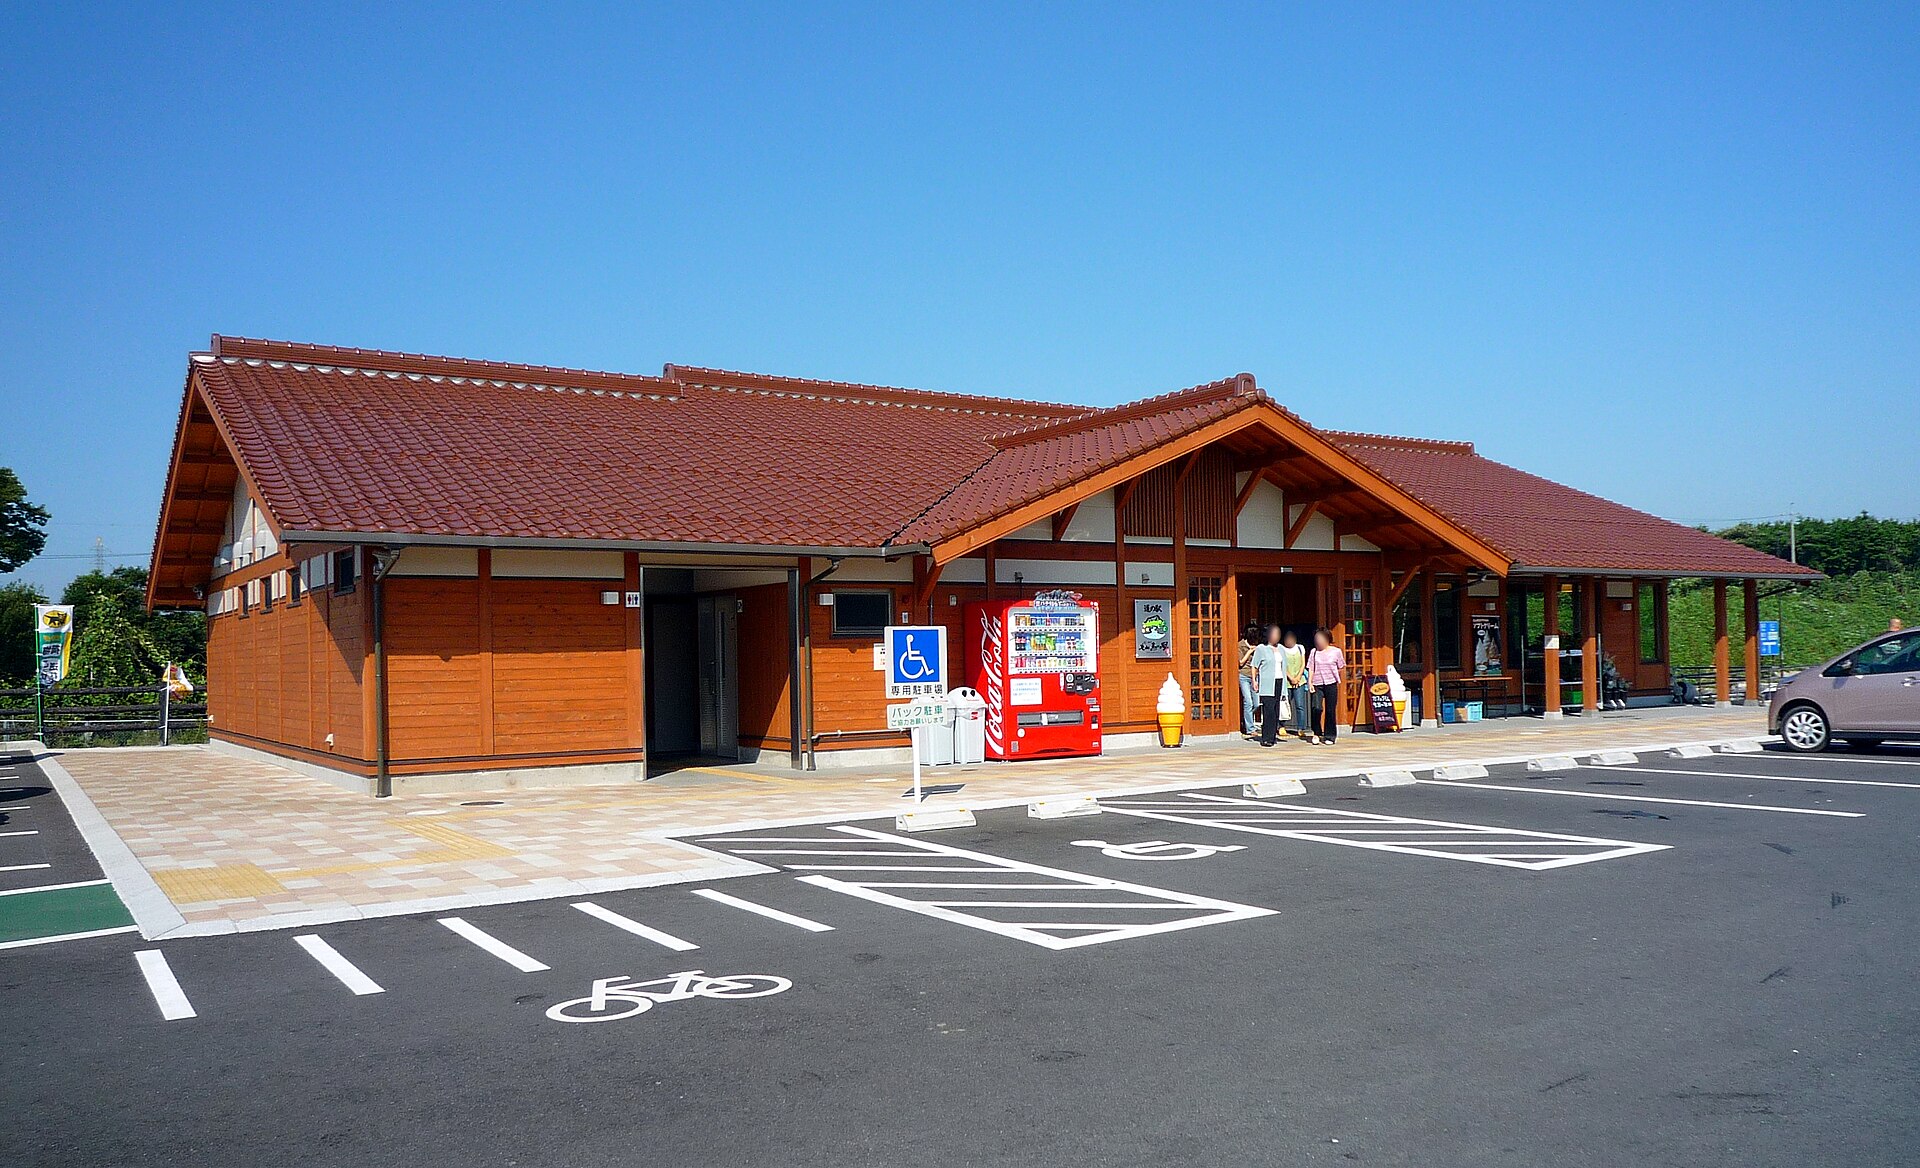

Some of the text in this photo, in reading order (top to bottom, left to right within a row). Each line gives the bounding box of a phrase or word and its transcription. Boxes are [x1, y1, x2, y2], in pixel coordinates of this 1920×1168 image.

[891, 684, 943, 695] 専用駐車場
[892, 705, 943, 718] バック駐車
[891, 716, 944, 727] ご協力お願いします
